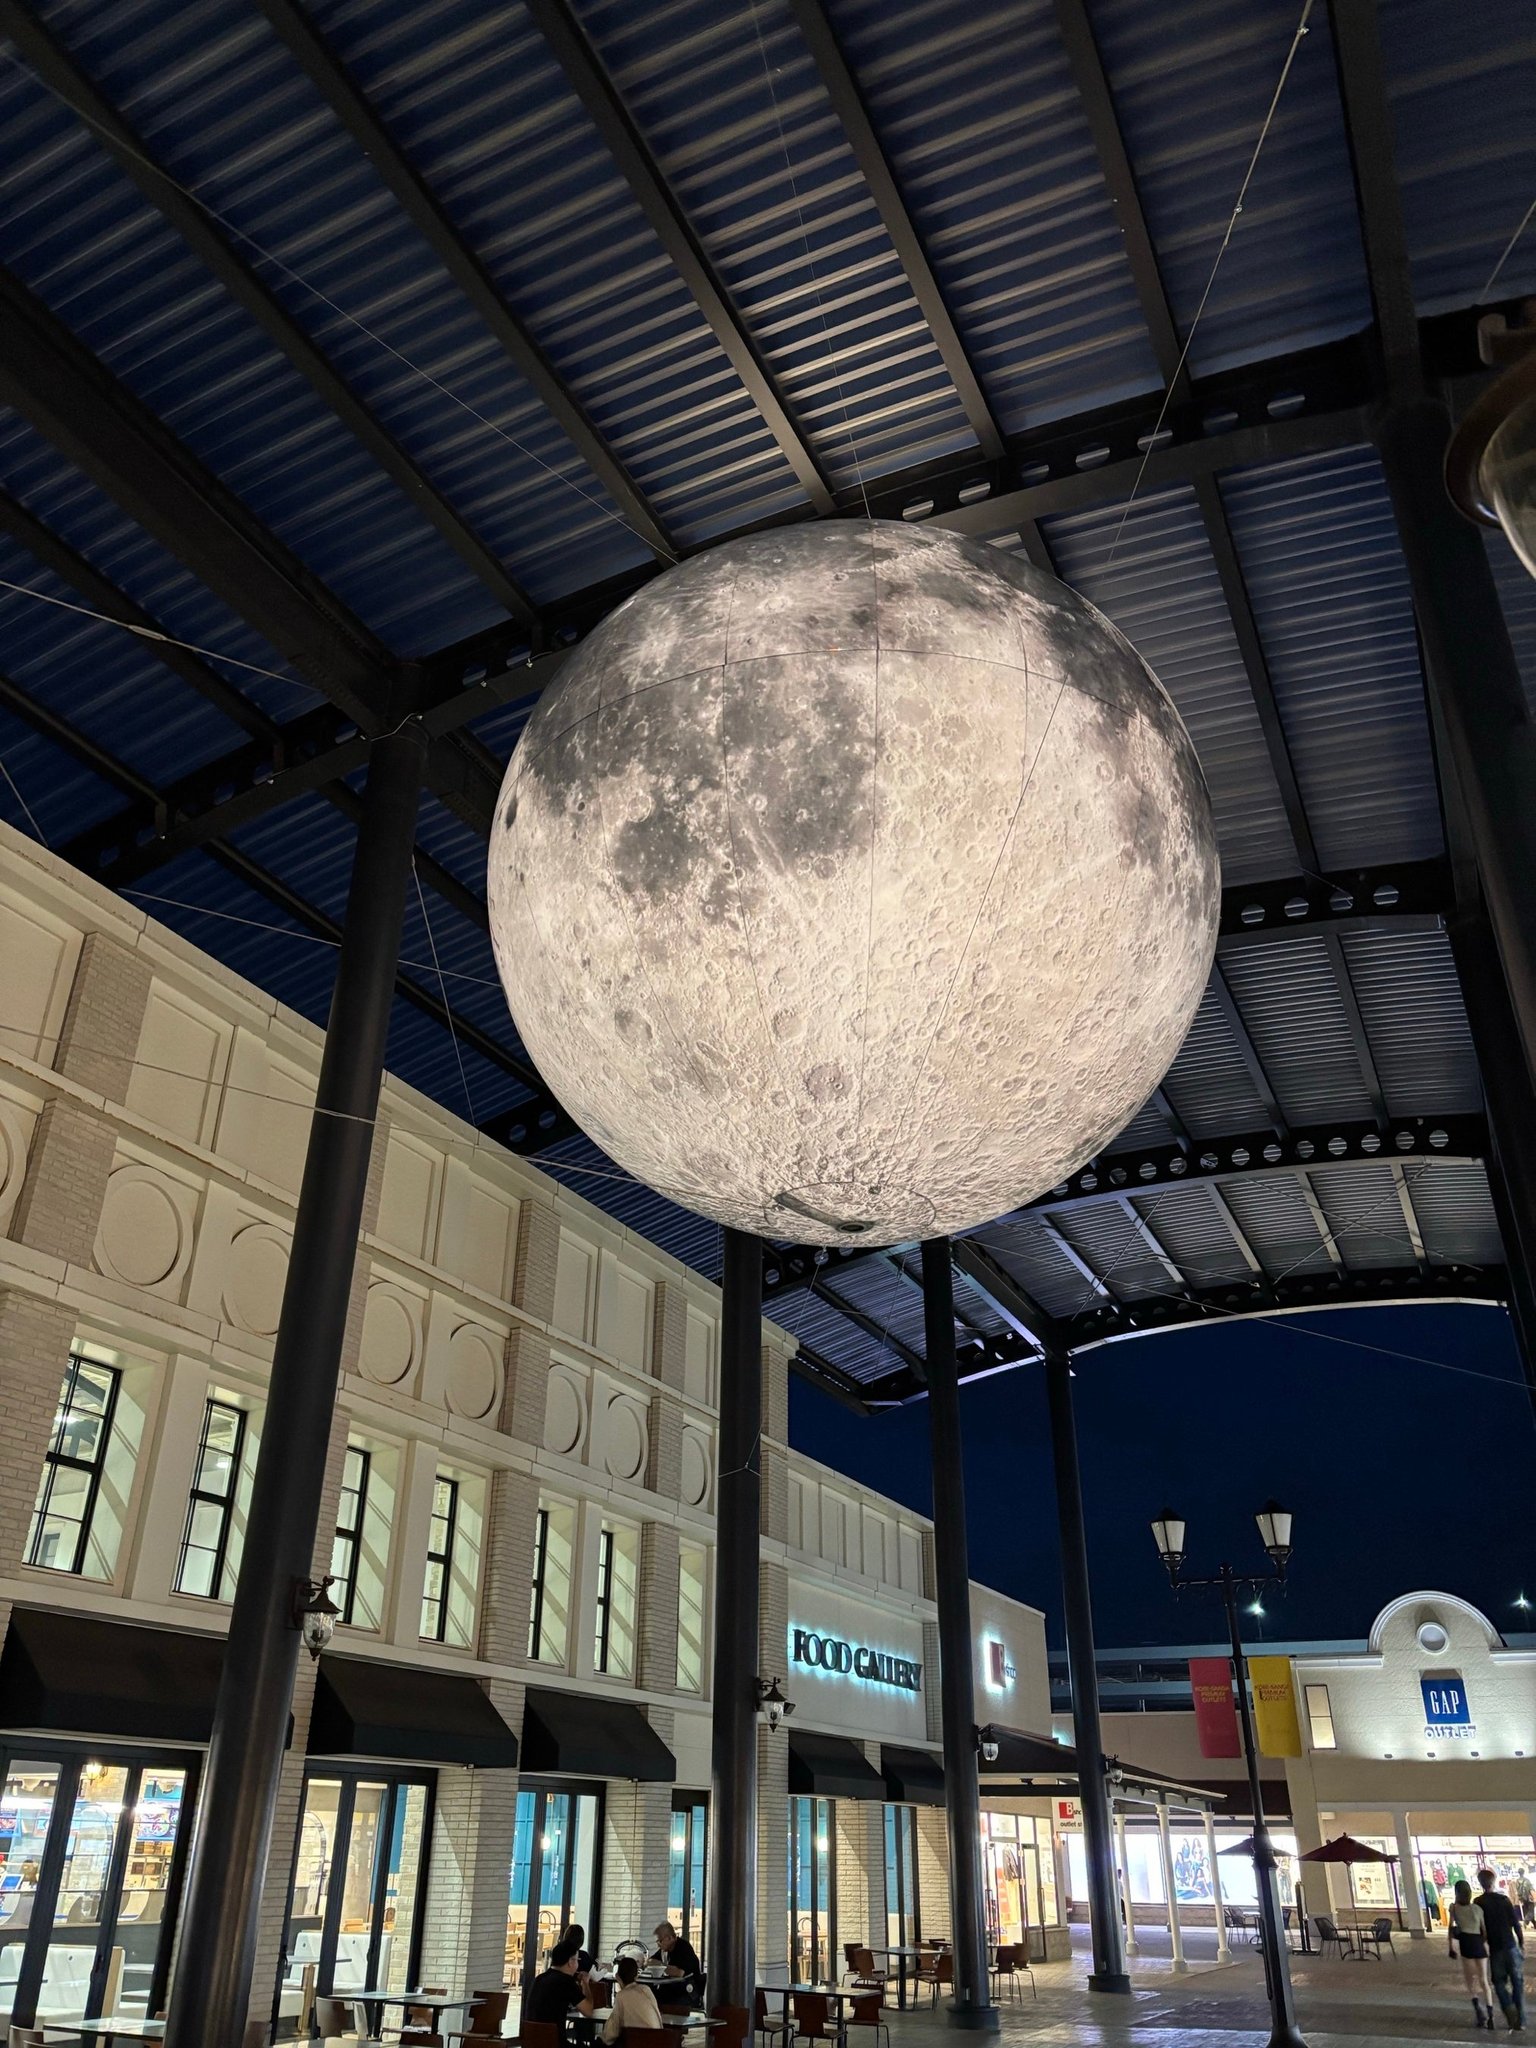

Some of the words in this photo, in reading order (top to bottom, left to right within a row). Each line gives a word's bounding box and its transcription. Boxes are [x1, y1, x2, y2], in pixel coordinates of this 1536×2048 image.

[793, 1629, 852, 1674] FOOD
[854, 1648, 923, 1692] GALLERY
[1430, 1690, 1460, 1715] GAP
[1424, 1726, 1476, 1739] OUTLET
